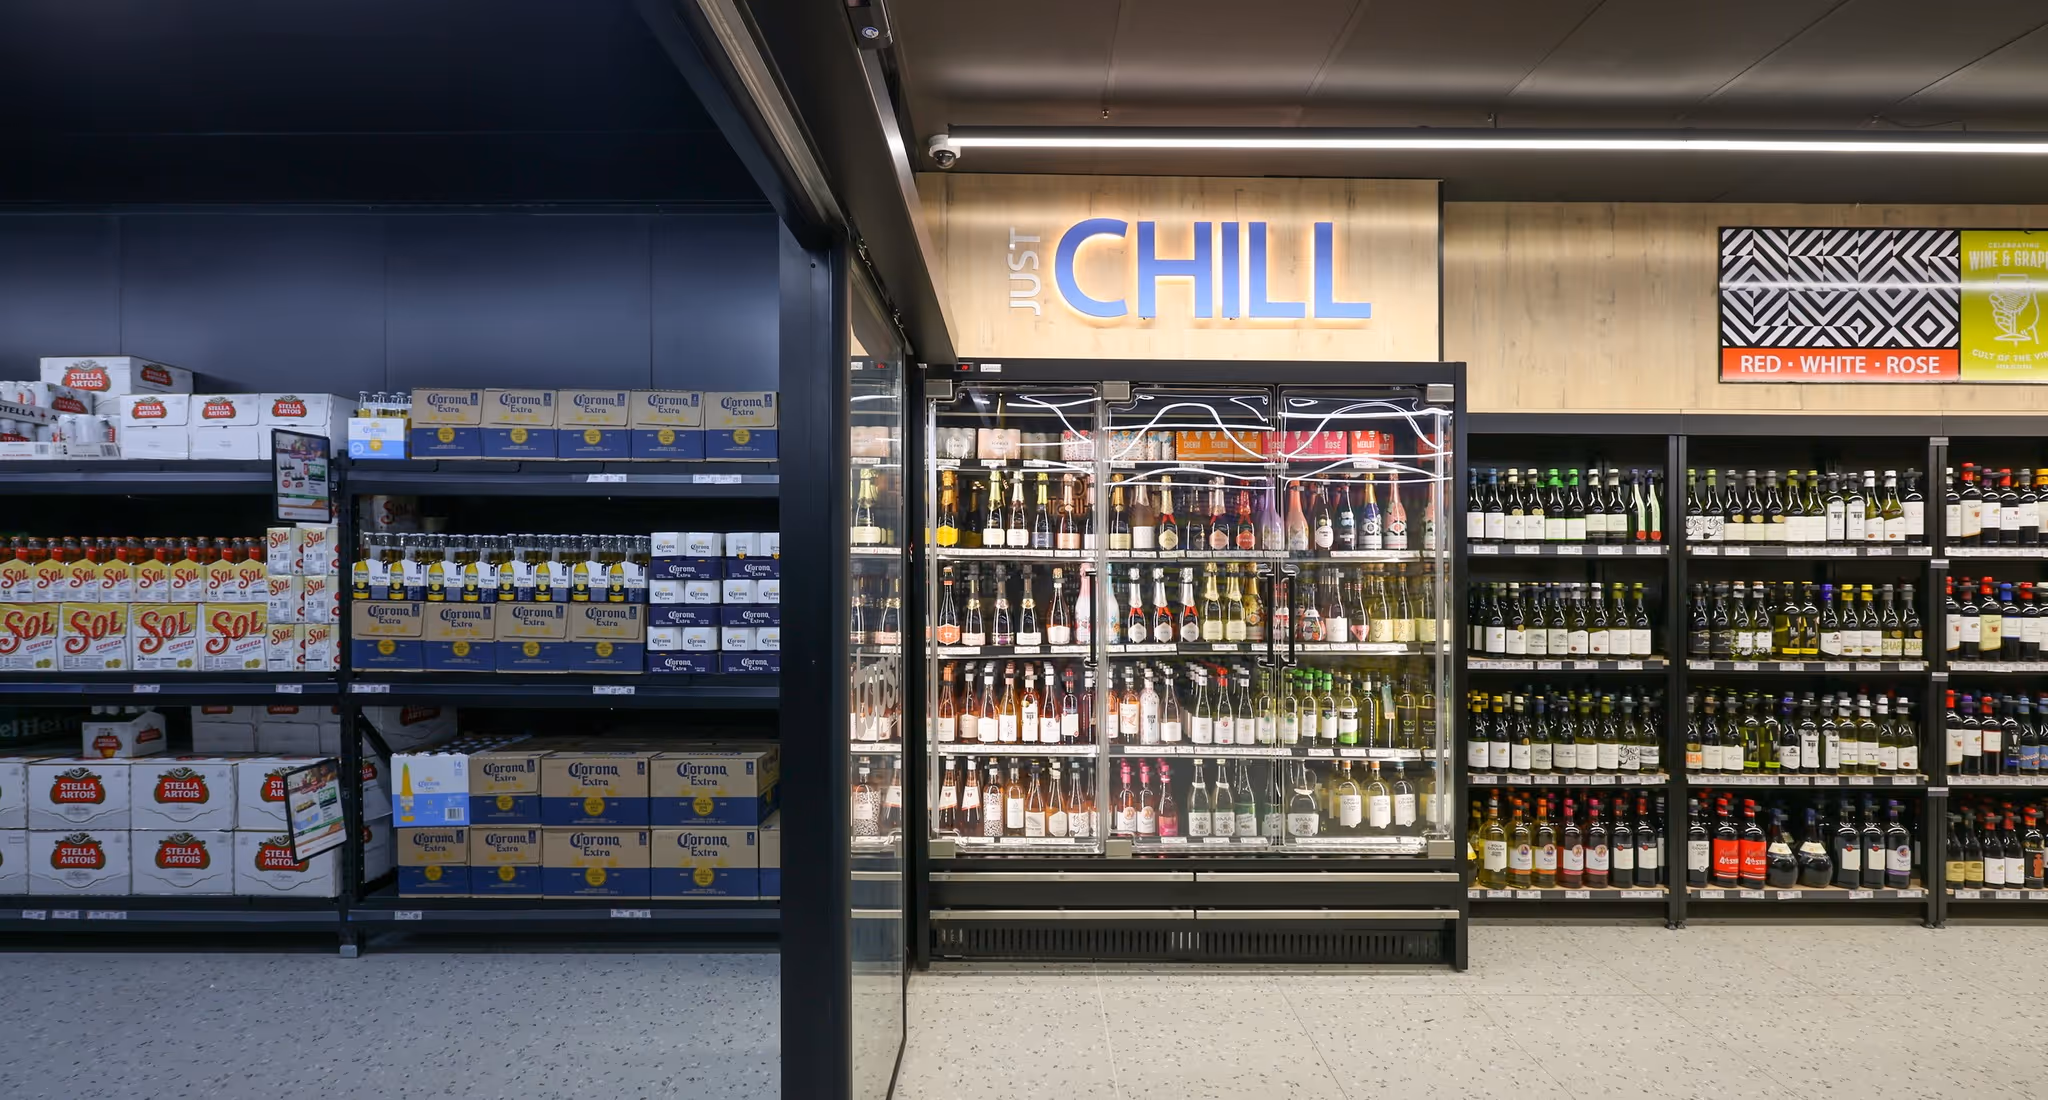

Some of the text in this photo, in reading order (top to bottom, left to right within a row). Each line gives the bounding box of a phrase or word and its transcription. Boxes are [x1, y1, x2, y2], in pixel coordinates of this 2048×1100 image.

[1968, 250, 1999, 271] WINE
[2002, 250, 2011, 267] &
[1007, 227, 1041, 316] JUST
[1054, 217, 1372, 319] CHILL
[1972, 349, 1995, 360] CULT
[1998, 354, 2010, 362] OF
[2013, 354, 2032, 362] THE
[1741, 356, 1940, 374] RED WHITE ROSE
[70, 380, 103, 388] ARTOIS
[427, 393, 469, 407] Corona
[500, 393, 542, 408] Corona
[573, 394, 616, 408] Corona
[648, 394, 690, 408] Corona
[720, 396, 763, 410] Corona
[438, 405, 460, 413] Extra
[510, 405, 532, 414] Extra
[584, 406, 606, 414] Extra
[658, 406, 680, 414] Extra
[732, 408, 754, 416] Extra
[270, 532, 289, 548] SOL
[306, 532, 325, 548] SOL
[668, 565, 696, 573] Corona
[744, 564, 772, 572] Corona
[1, 568, 29, 589] SOL
[36, 568, 65, 589] SOL
[70, 568, 97, 588] SOL
[102, 568, 129, 589] SOL
[139, 568, 166, 589] SOL
[172, 568, 200, 588] SOL
[208, 568, 235, 590] SOL
[238, 568, 264, 590] SOL
[270, 580, 290, 596] SOL
[306, 580, 326, 596] SOL
[368, 604, 411, 618] Corona
[440, 608, 482, 621] Corona
[512, 605, 554, 619] Corona
[586, 606, 628, 620] Corona
[668, 610, 696, 619] Corona
[742, 610, 770, 619] Corona
[378, 616, 400, 624] Extra
[451, 620, 472, 628] Extra
[523, 617, 545, 626] Extra
[596, 618, 618, 626] Extra
[0, 611, 55, 655] SOL
[65, 610, 123, 655] SOL
[139, 610, 192, 655] SOL
[205, 610, 264, 655] SOL
[271, 628, 292, 645] SOL
[308, 628, 328, 645] SOL
[26, 640, 53, 651] CERVEZA
[96, 640, 122, 651] CERVEZA
[168, 640, 194, 651] CERVEZA
[235, 640, 262, 651] CERVEZA
[664, 658, 692, 666] Corona
[741, 658, 768, 666] Corona
[484, 762, 526, 776] Corona
[568, 762, 620, 778] Corona
[676, 762, 729, 778] Corona
[494, 774, 517, 782] Extra
[582, 776, 609, 786] Extra
[690, 776, 718, 786] Extra
[60, 782, 96, 790] STELLA
[164, 782, 199, 790] STELLA
[164, 790, 200, 798] ARTOIS
[413, 832, 456, 845] Corona
[485, 833, 528, 846] Corona
[570, 832, 622, 848] Corona
[678, 832, 730, 848] Corona
[264, 850, 292, 858] STELL
[424, 844, 446, 852] Extra
[496, 844, 518, 852] Extra
[584, 847, 610, 857] Extra
[691, 847, 718, 857] Extra
[61, 856, 96, 864] ARTOIS
[165, 856, 200, 864] ARTOIS
